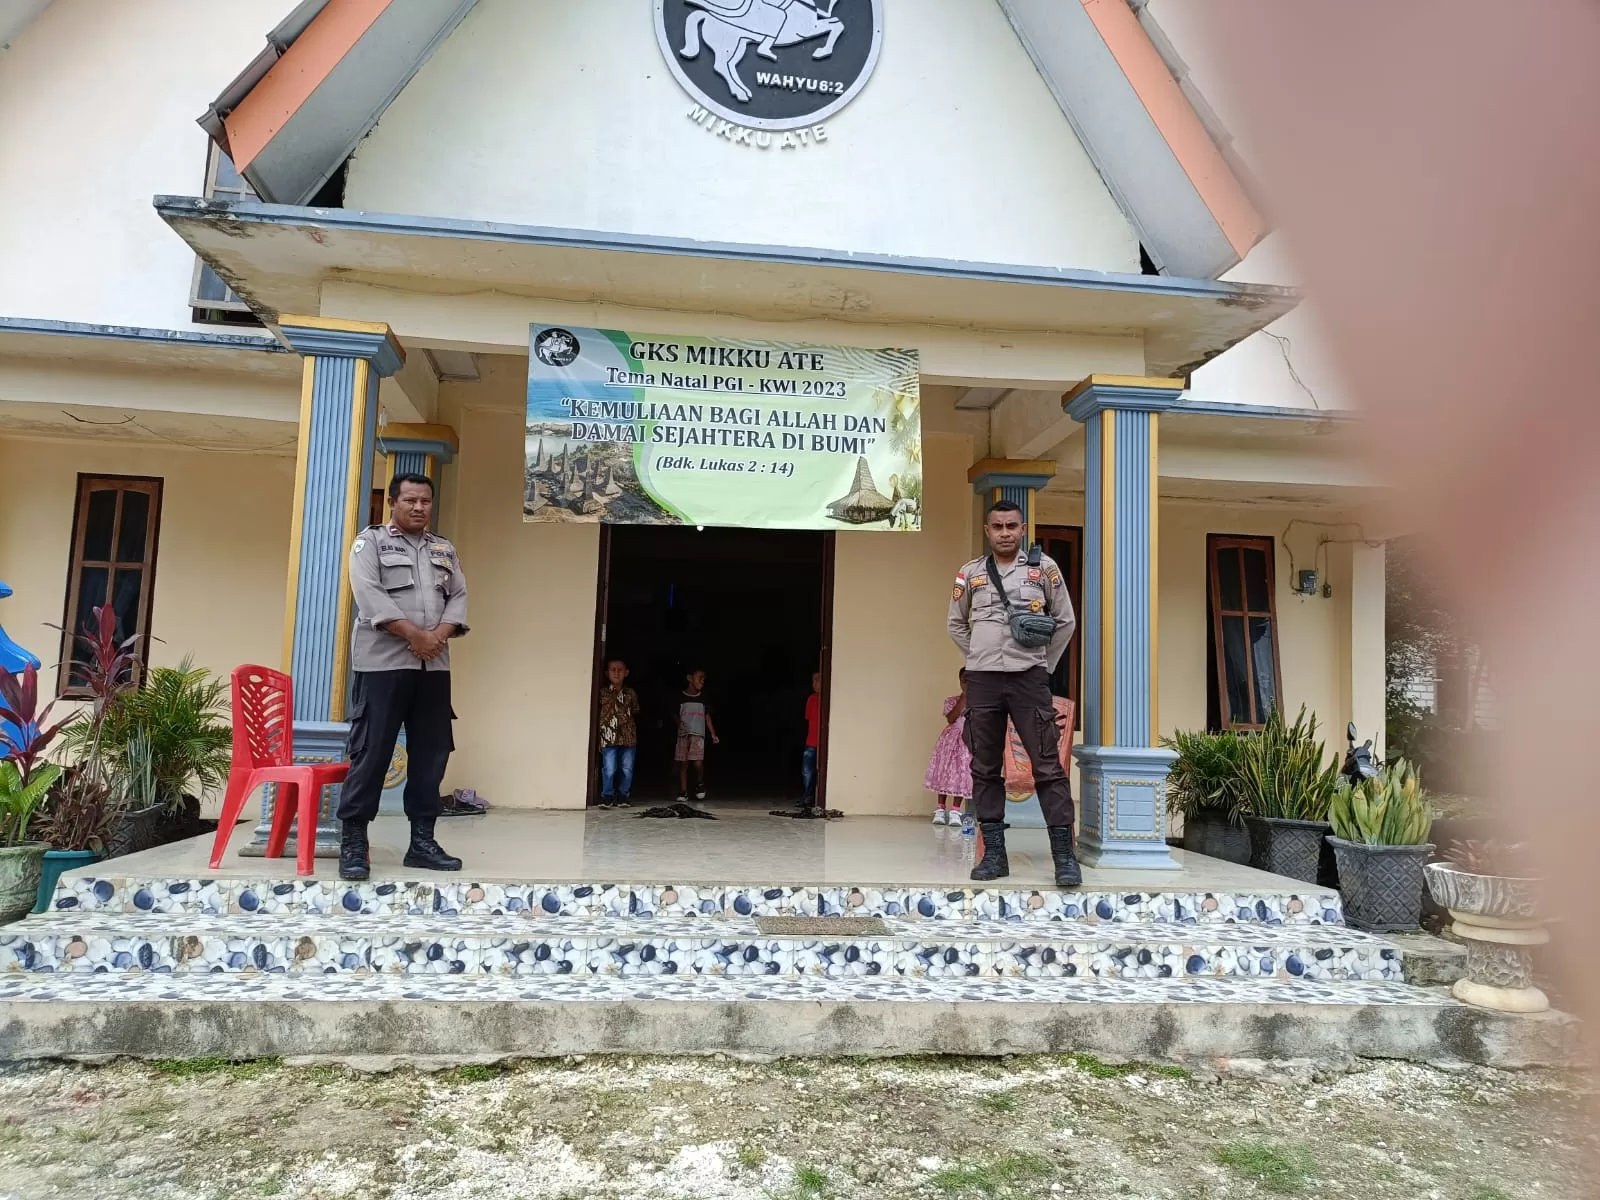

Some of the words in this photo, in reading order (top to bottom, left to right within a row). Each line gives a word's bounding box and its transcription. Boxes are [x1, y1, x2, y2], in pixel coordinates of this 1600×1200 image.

[686, 103, 773, 149] MIKKU
[781, 124, 828, 149] ATE
[630, 341, 679, 363] GKS
[686, 345, 770, 369] MIKKU
[777, 351, 824, 371] ATE
[606, 367, 655, 384] Tema
[660, 372, 708, 389] Natal
[713, 375, 743, 391] PGI
[759, 378, 797, 394] KWI
[802, 380, 847, 397] 2023
[561, 398, 703, 423] “KEMULIAAN
[709, 406, 761, 426] BAGI
[766, 409, 837, 431] ALLAH
[843, 414, 886, 433] DAN
[571, 422, 646, 443] DAMAI
[652, 425, 775, 449] SEJAHTERA
[782, 432, 804, 451] DI
[811, 434, 876, 455] BUMI”
[656, 455, 695, 472] (Bdk.
[700, 458, 745, 472] Lukas
[747, 460, 758, 473] 2
[769, 461, 795, 478] 14)
